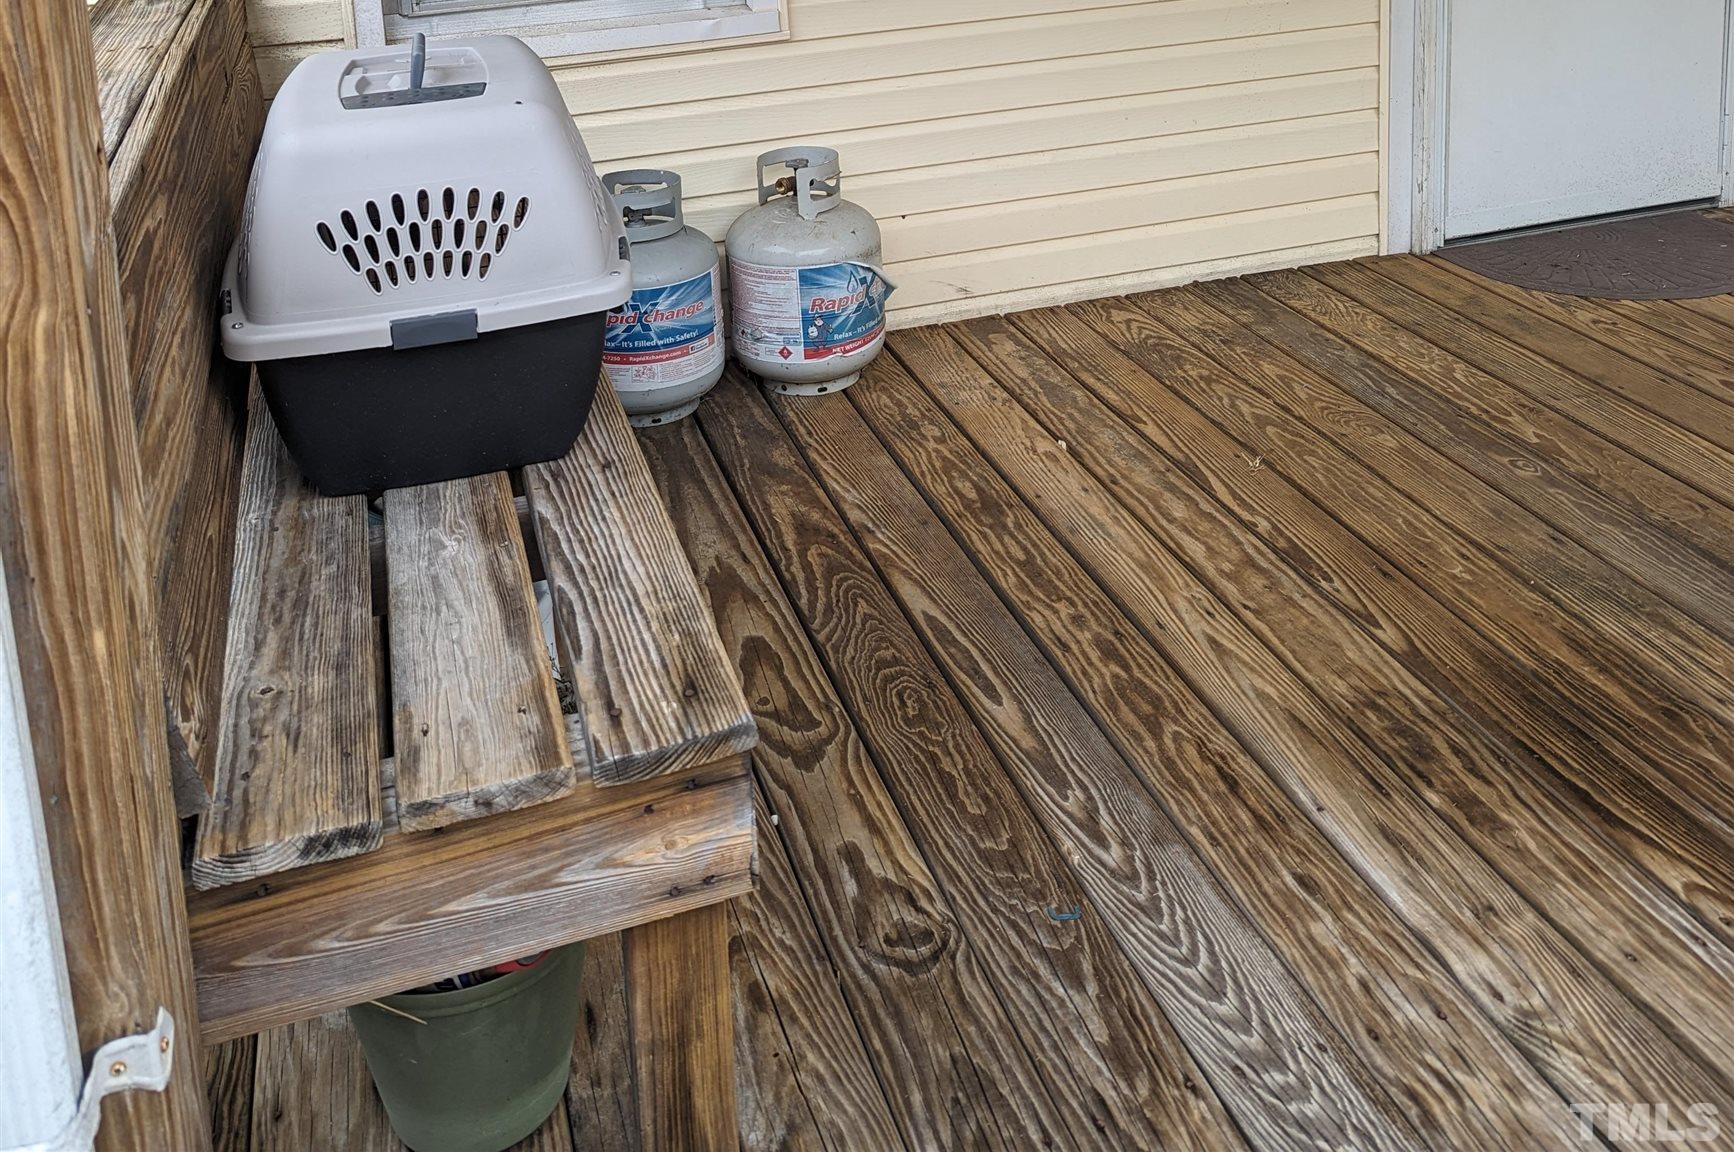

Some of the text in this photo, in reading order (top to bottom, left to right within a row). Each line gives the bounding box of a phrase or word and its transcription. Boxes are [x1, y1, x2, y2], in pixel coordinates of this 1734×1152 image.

[809, 284, 867, 313] Rapid
[634, 337, 656, 348] Filled
[656, 336, 675, 346] with
[675, 328, 699, 342] Safety!
[833, 332, 853, 341] Relax
[845, 340, 865, 352] WEIGHT
